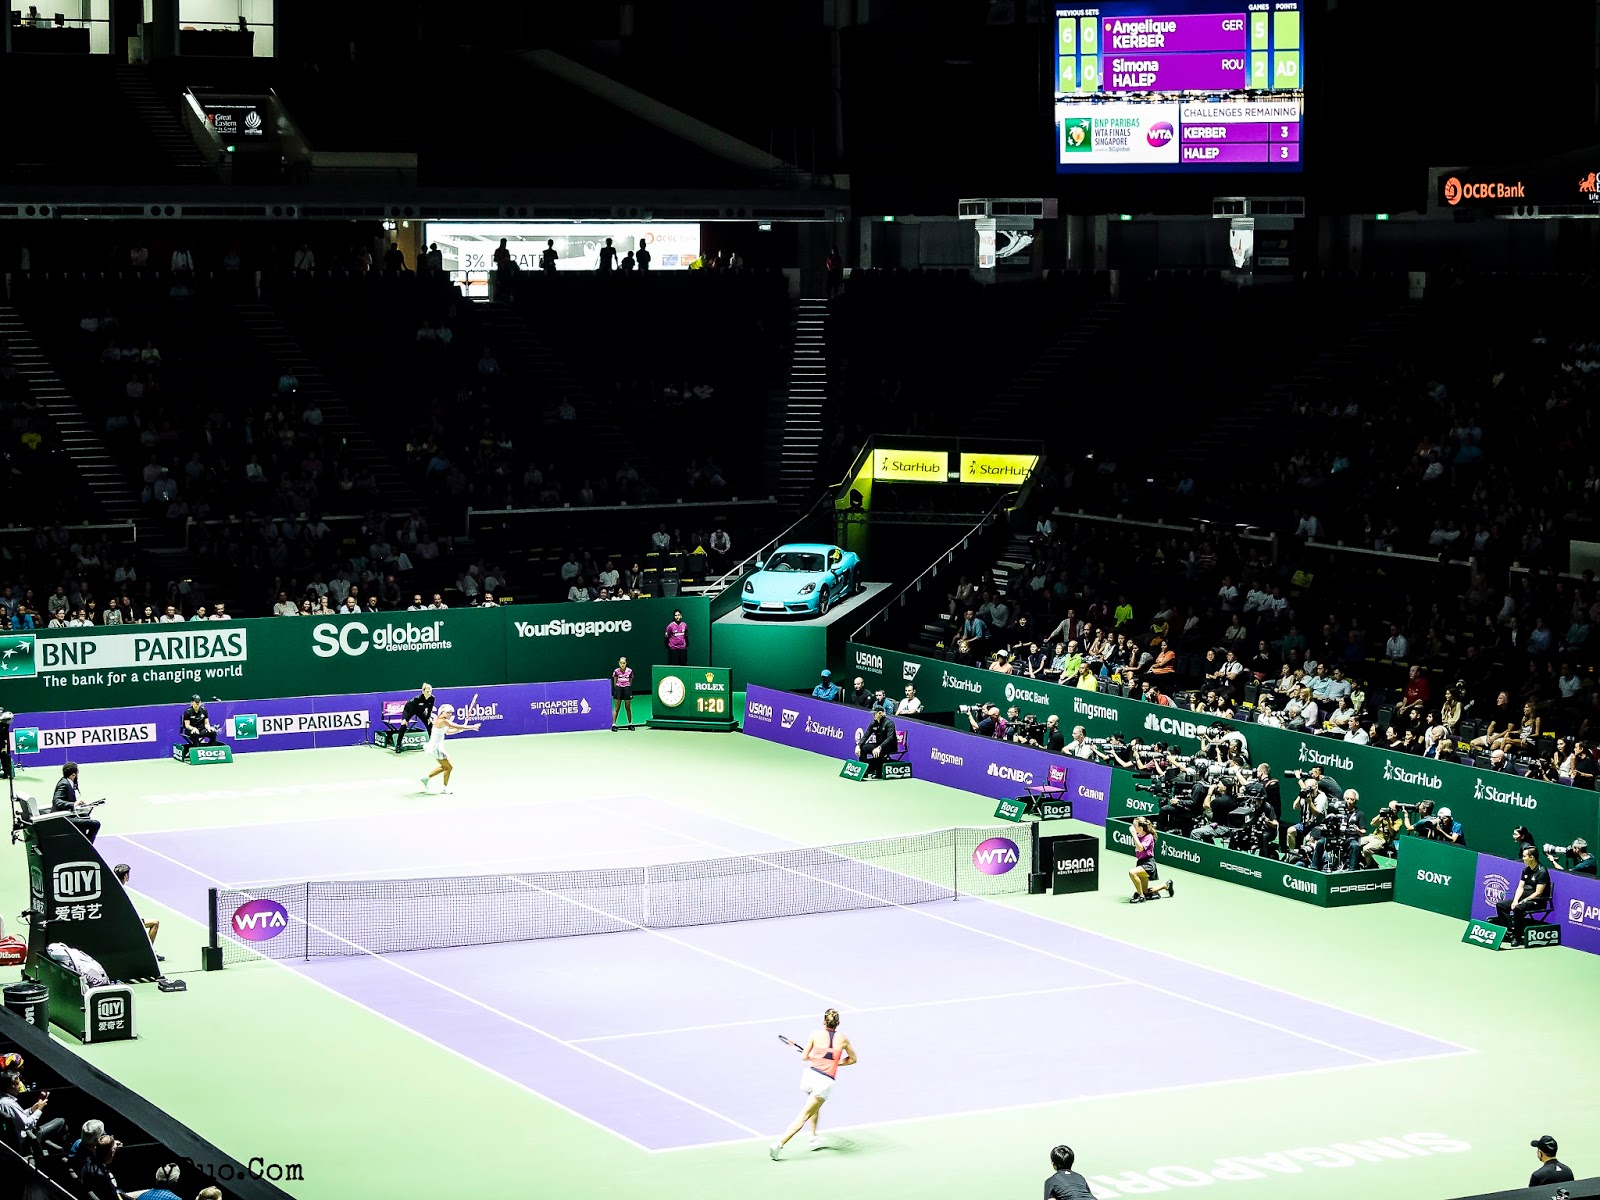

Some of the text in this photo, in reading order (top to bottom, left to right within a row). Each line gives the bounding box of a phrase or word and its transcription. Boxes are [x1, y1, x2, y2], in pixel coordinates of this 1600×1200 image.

[1056, 8, 1099, 17] PREVIOUS SETS
[1112, 19, 1177, 35] Angelique
[1222, 20, 1244, 31] GER
[1254, 22, 1265, 38] 5
[1062, 27, 1073, 44] 6
[1083, 26, 1095, 43] 0
[1112, 35, 1165, 49] KERBER
[1083, 64, 1095, 81] 0
[1112, 58, 1159, 72] Simona
[1222, 59, 1244, 70] ROU
[1254, 61, 1265, 77] 2
[1275, 61, 1297, 77] AD
[1062, 65, 1073, 81] 4
[1112, 73, 1156, 87] HALEP
[1184, 107, 1296, 117] CHALLENGES REMAINING
[1094, 118, 1140, 128] BNP PARIBAS
[1095, 128, 1131, 137] WTA FINALS
[1148, 129, 1173, 140] WTA
[1183, 126, 1288, 139] KERBER 3
[1095, 138, 1127, 146] SINGAPORE
[1183, 147, 1288, 159] HALEP 3
[1463, 181, 1525, 199] OCBC Bank
[465, 254, 485, 268] 3%
[892, 461, 940, 473] StarHub
[979, 464, 1029, 476] StarHub
[514, 619, 632, 638] YourSingapore
[312, 621, 444, 658] SC global
[385, 640, 452, 652] developments
[42, 633, 243, 667] BNP PARIBAS
[855, 651, 883, 668] USANA
[43, 664, 243, 688] The bank for a changing world
[904, 664, 917, 677] SAP
[695, 683, 724, 691] ROLEX
[948, 675, 982, 694] StarHub
[530, 700, 579, 709] SINGAPORE
[697, 697, 724, 713] 1:20
[1015, 688, 1050, 706] OCBC Bank
[540, 706, 579, 715] AIRLINES
[748, 701, 773, 717] USANA
[1073, 697, 1118, 721] Kingsmen
[262, 712, 362, 732] BNP PARIBAS
[782, 711, 795, 726] SAP
[811, 721, 844, 739] StarHub
[1160, 717, 1197, 739] CNB
[43, 727, 149, 746] BNP PARIBAS
[402, 735, 427, 744] Roca
[197, 750, 226, 758] Roca
[931, 747, 963, 766] Kingsmen
[1308, 749, 1354, 771] StarHub
[846, 763, 862, 774] Roca
[885, 765, 911, 774] Roca
[998, 766, 1033, 784] CNBC
[1393, 767, 1442, 790] StarHub
[1078, 785, 1104, 801] Canon
[1485, 786, 1538, 810] StarHub
[1001, 801, 1019, 813] Roca
[1044, 805, 1071, 815] Roca
[1126, 798, 1155, 813] SONY
[1112, 830, 1136, 847] Can
[976, 848, 1018, 865] WTA
[1167, 846, 1201, 864] StarHub
[1057, 858, 1095, 871] USANA
[1219, 861, 1263, 879] PORSCHE
[1282, 874, 1318, 895] Canon
[1416, 869, 1452, 886] SONY
[1330, 881, 1393, 894] PORSCHE
[55, 903, 102, 921] 爱奇艺
[235, 910, 287, 930] WTA
[1584, 905, 1600, 921] AP
[1471, 924, 1497, 940] Roca
[1527, 929, 1559, 941] Roca
[98, 1020, 125, 1031] 爱奇艺
